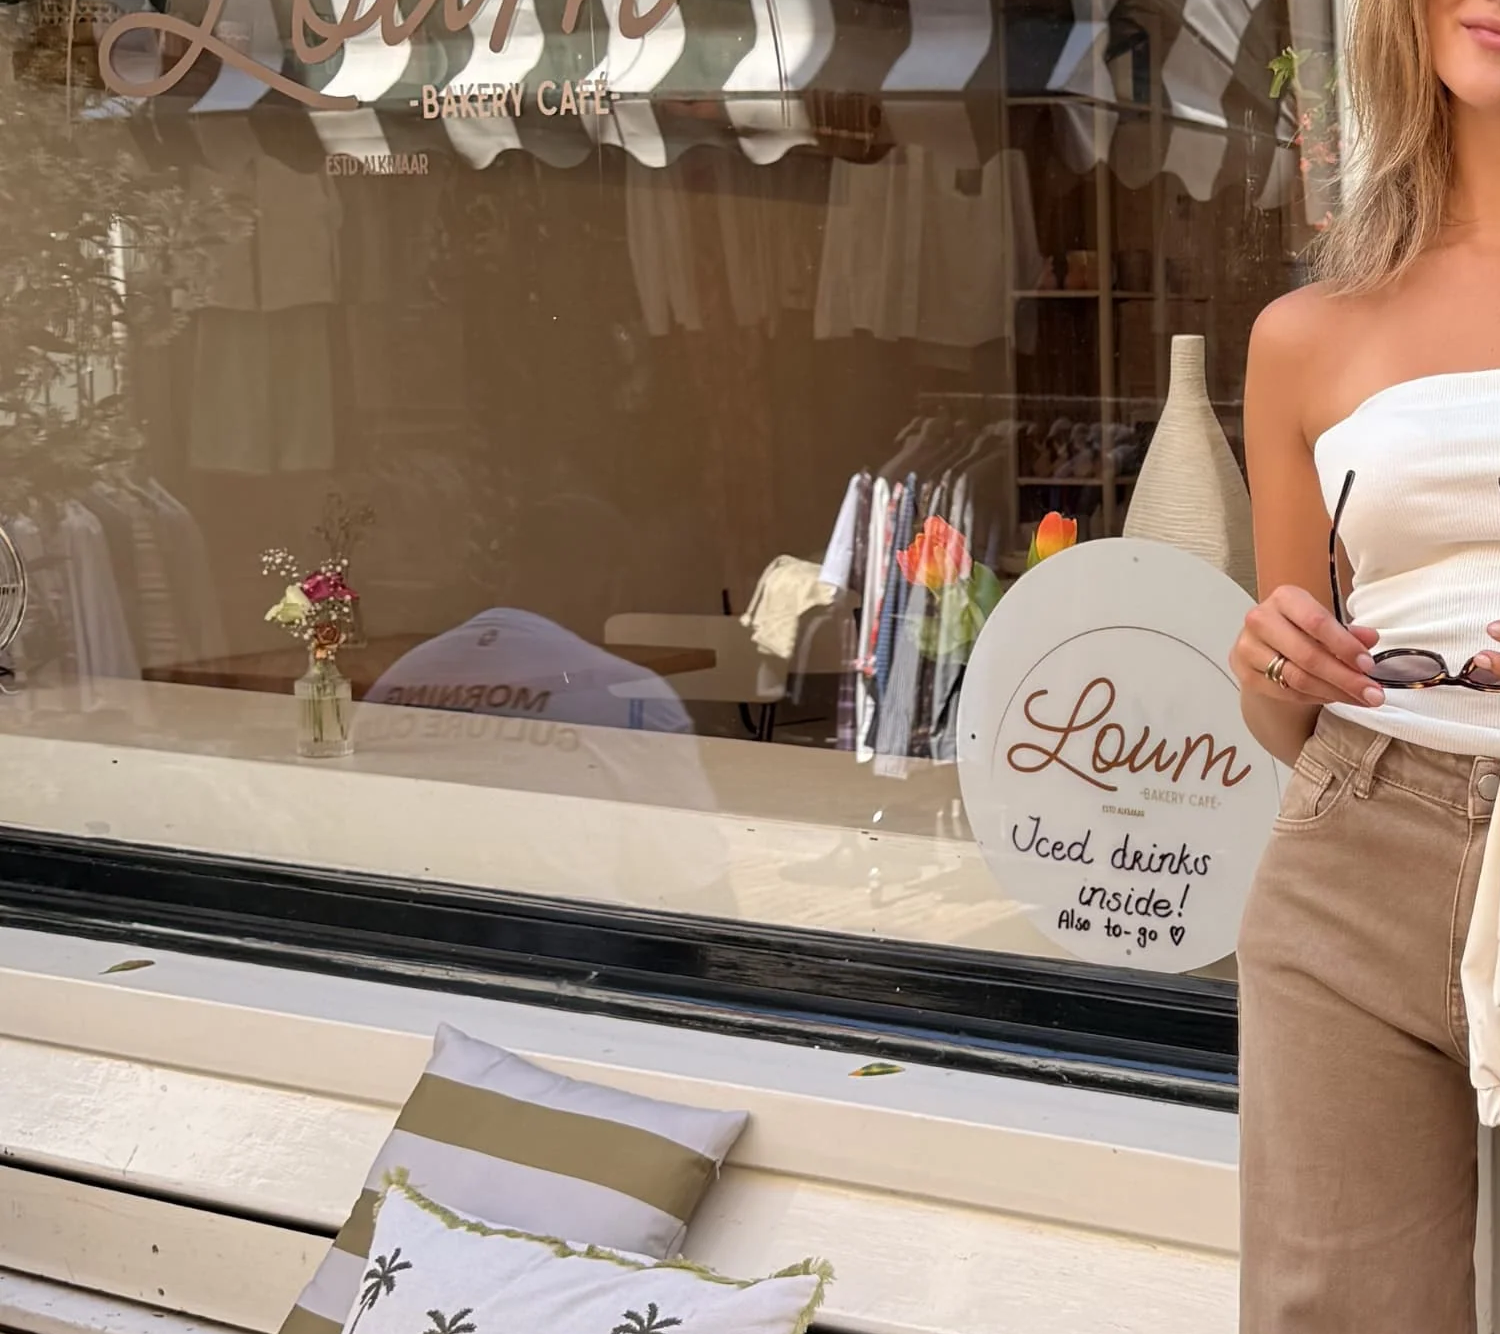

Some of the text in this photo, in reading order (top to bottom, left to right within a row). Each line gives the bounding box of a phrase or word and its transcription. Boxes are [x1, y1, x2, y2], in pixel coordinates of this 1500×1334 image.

[1007, 677, 1252, 792] Loum
[1012, 815, 1212, 876] Iced drinks
[1058, 908, 1091, 932] Also
[1078, 883, 1190, 918] inside!
